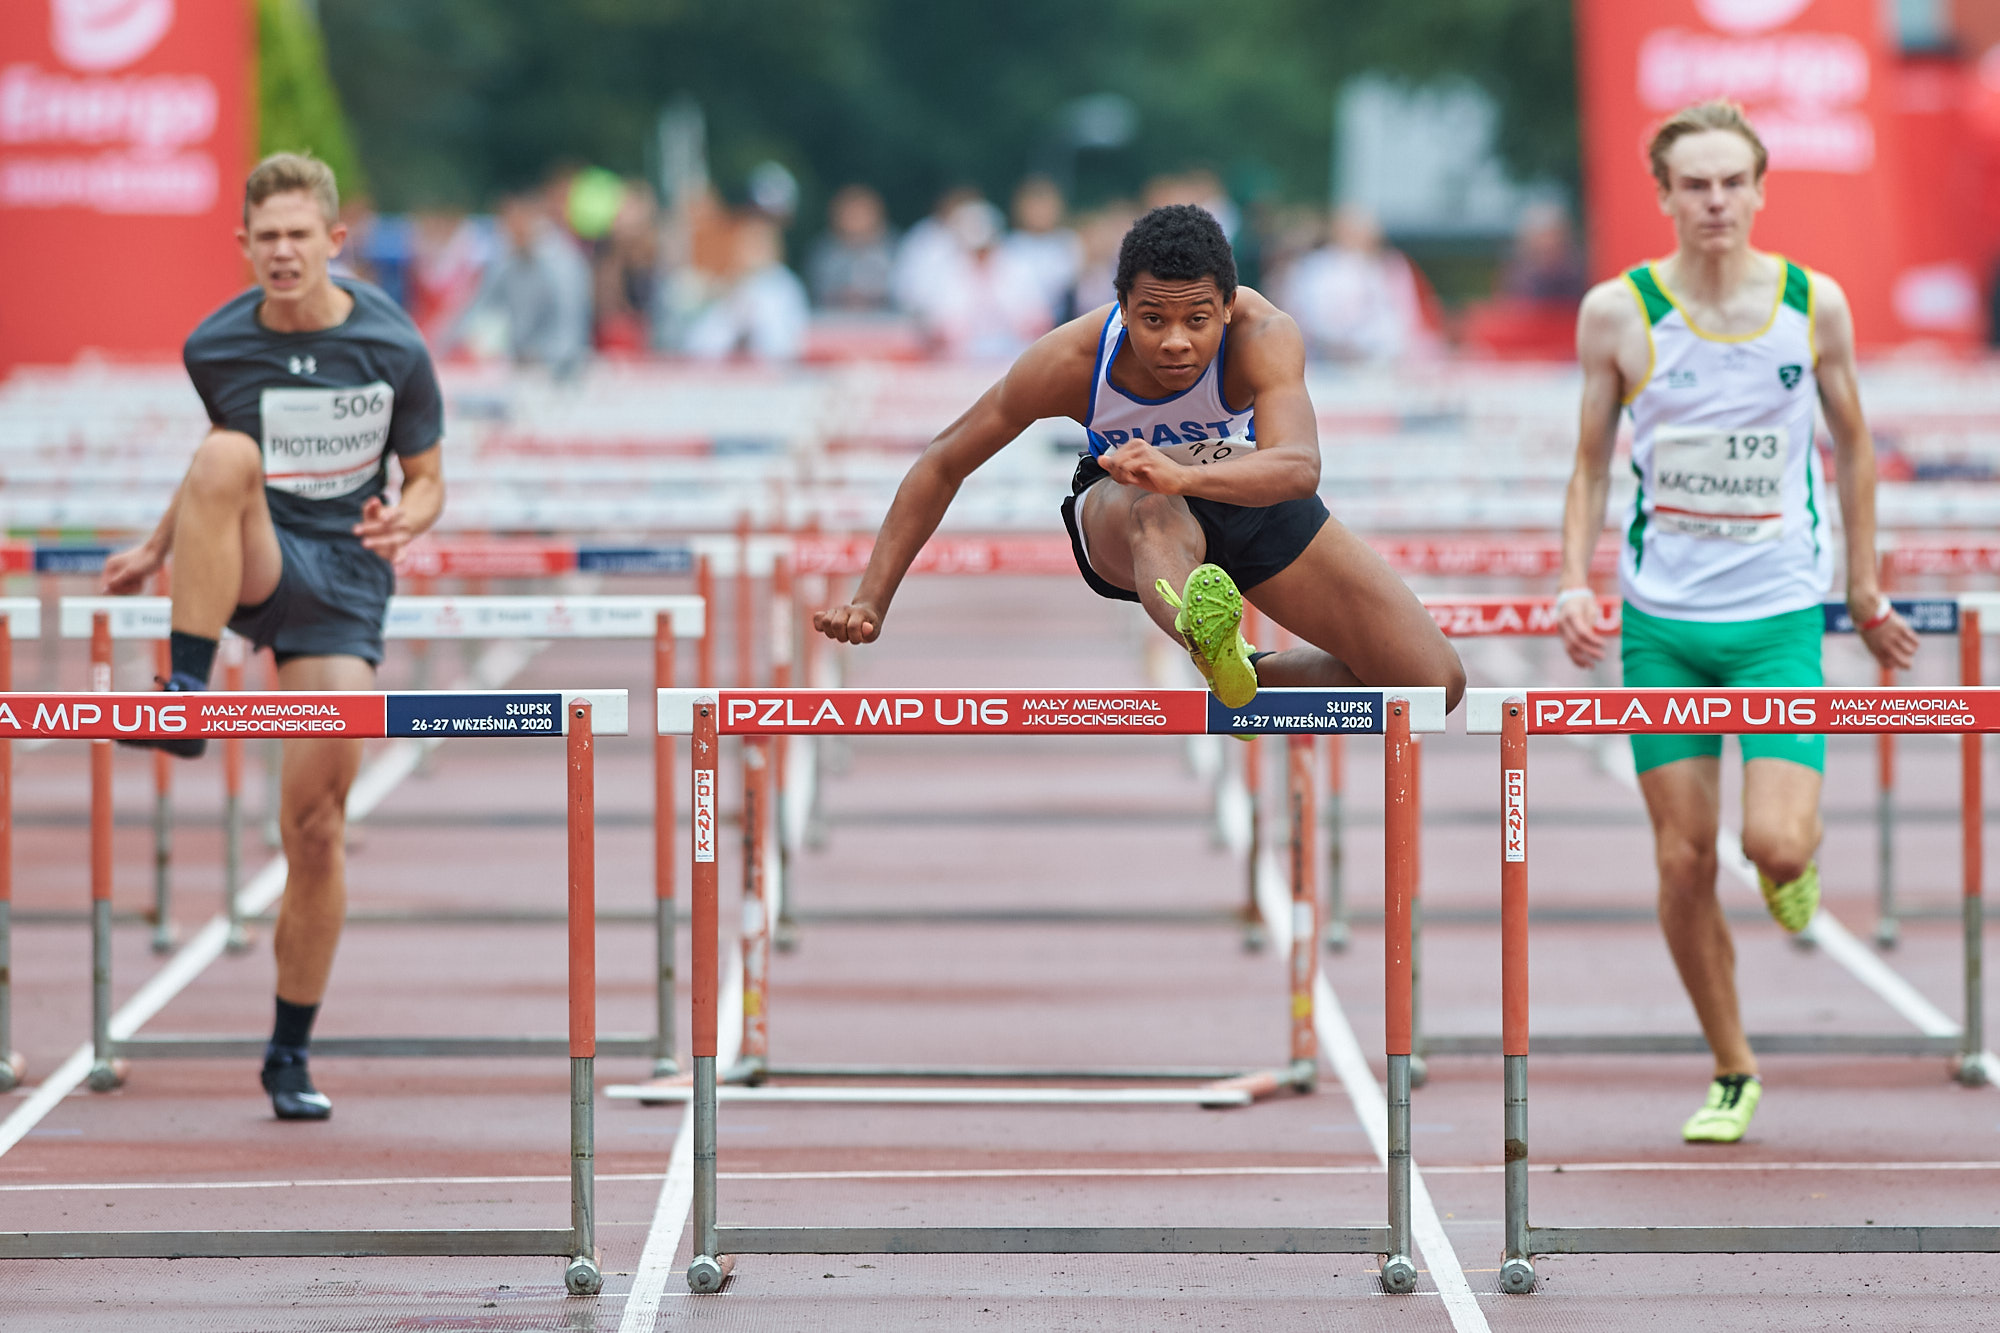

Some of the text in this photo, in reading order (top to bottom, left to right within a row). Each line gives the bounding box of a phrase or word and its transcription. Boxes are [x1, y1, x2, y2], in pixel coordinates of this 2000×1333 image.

[332, 393, 384, 420] 506
[1726, 434, 1778, 460] 193
[1658, 471, 1779, 497] KACZMAREK
[200, 704, 340, 717] MAŁY MEMORIAŁ
[505, 703, 552, 716] SŁUPSK
[728, 698, 1009, 727] PZLA MP U16
[1022, 699, 1162, 711] MAŁY MEMORIAŁ
[1325, 701, 1374, 714] SŁUPSK
[1535, 697, 1817, 727] PZLA MP U16
[1829, 699, 1970, 711] MAŁY MEMORIAŁ
[32, 702, 102, 731] MP
[112, 704, 187, 732] U16
[200, 717, 346, 732] J.KUSOCIŃSKIEGO
[411, 715, 553, 731] 26-27 WRZEŚNIA 2020
[1021, 712, 1168, 727] J.KUSOCIŃSKIEGO
[1232, 712, 1374, 729] 26-27 WRZEŚNIA 2020
[1829, 712, 1977, 727] J.KUSOCIŃSKIEGO
[697, 771, 712, 852] POLANIK
[1508, 771, 1523, 852] POLANIK
